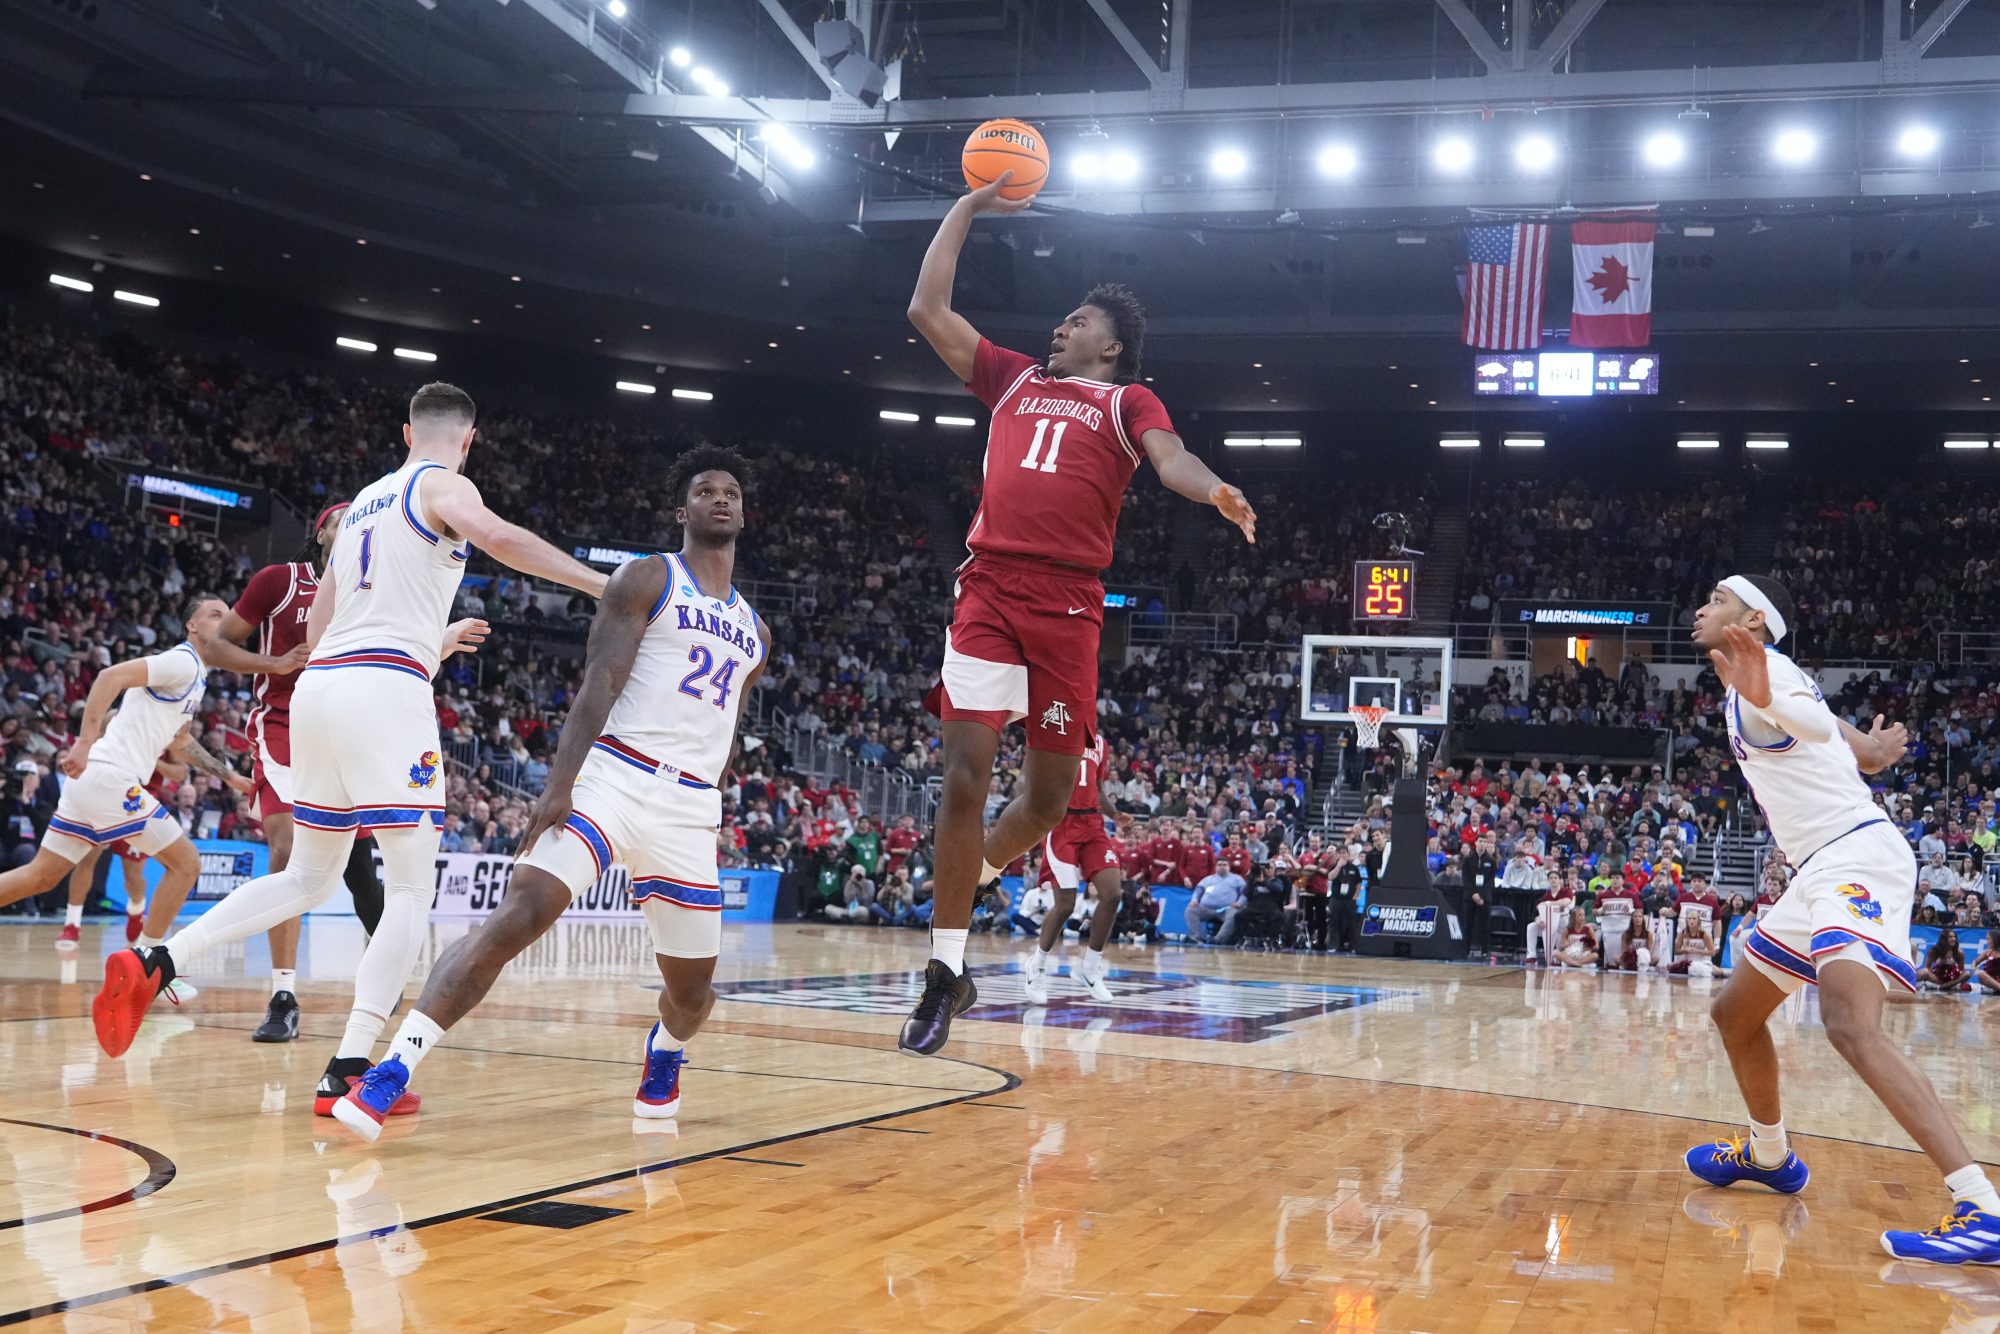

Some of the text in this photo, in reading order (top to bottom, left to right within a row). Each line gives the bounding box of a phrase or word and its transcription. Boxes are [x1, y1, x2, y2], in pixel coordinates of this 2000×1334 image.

[979, 130, 1036, 152] Wilson
[1014, 397, 1104, 432] RAZORBACKS
[1020, 418, 1068, 474] 11
[353, 526, 375, 592] 1
[1371, 566, 1409, 584] 6:41
[1366, 584, 1403, 614] 25
[1535, 609, 1635, 625] MARCHMADNESS
[675, 604, 756, 659] KANSAS
[678, 644, 740, 711] 24
[444, 875, 469, 896] AND
[1379, 907, 1417, 920] MARCH
[1382, 920, 1434, 933] MADNESS
